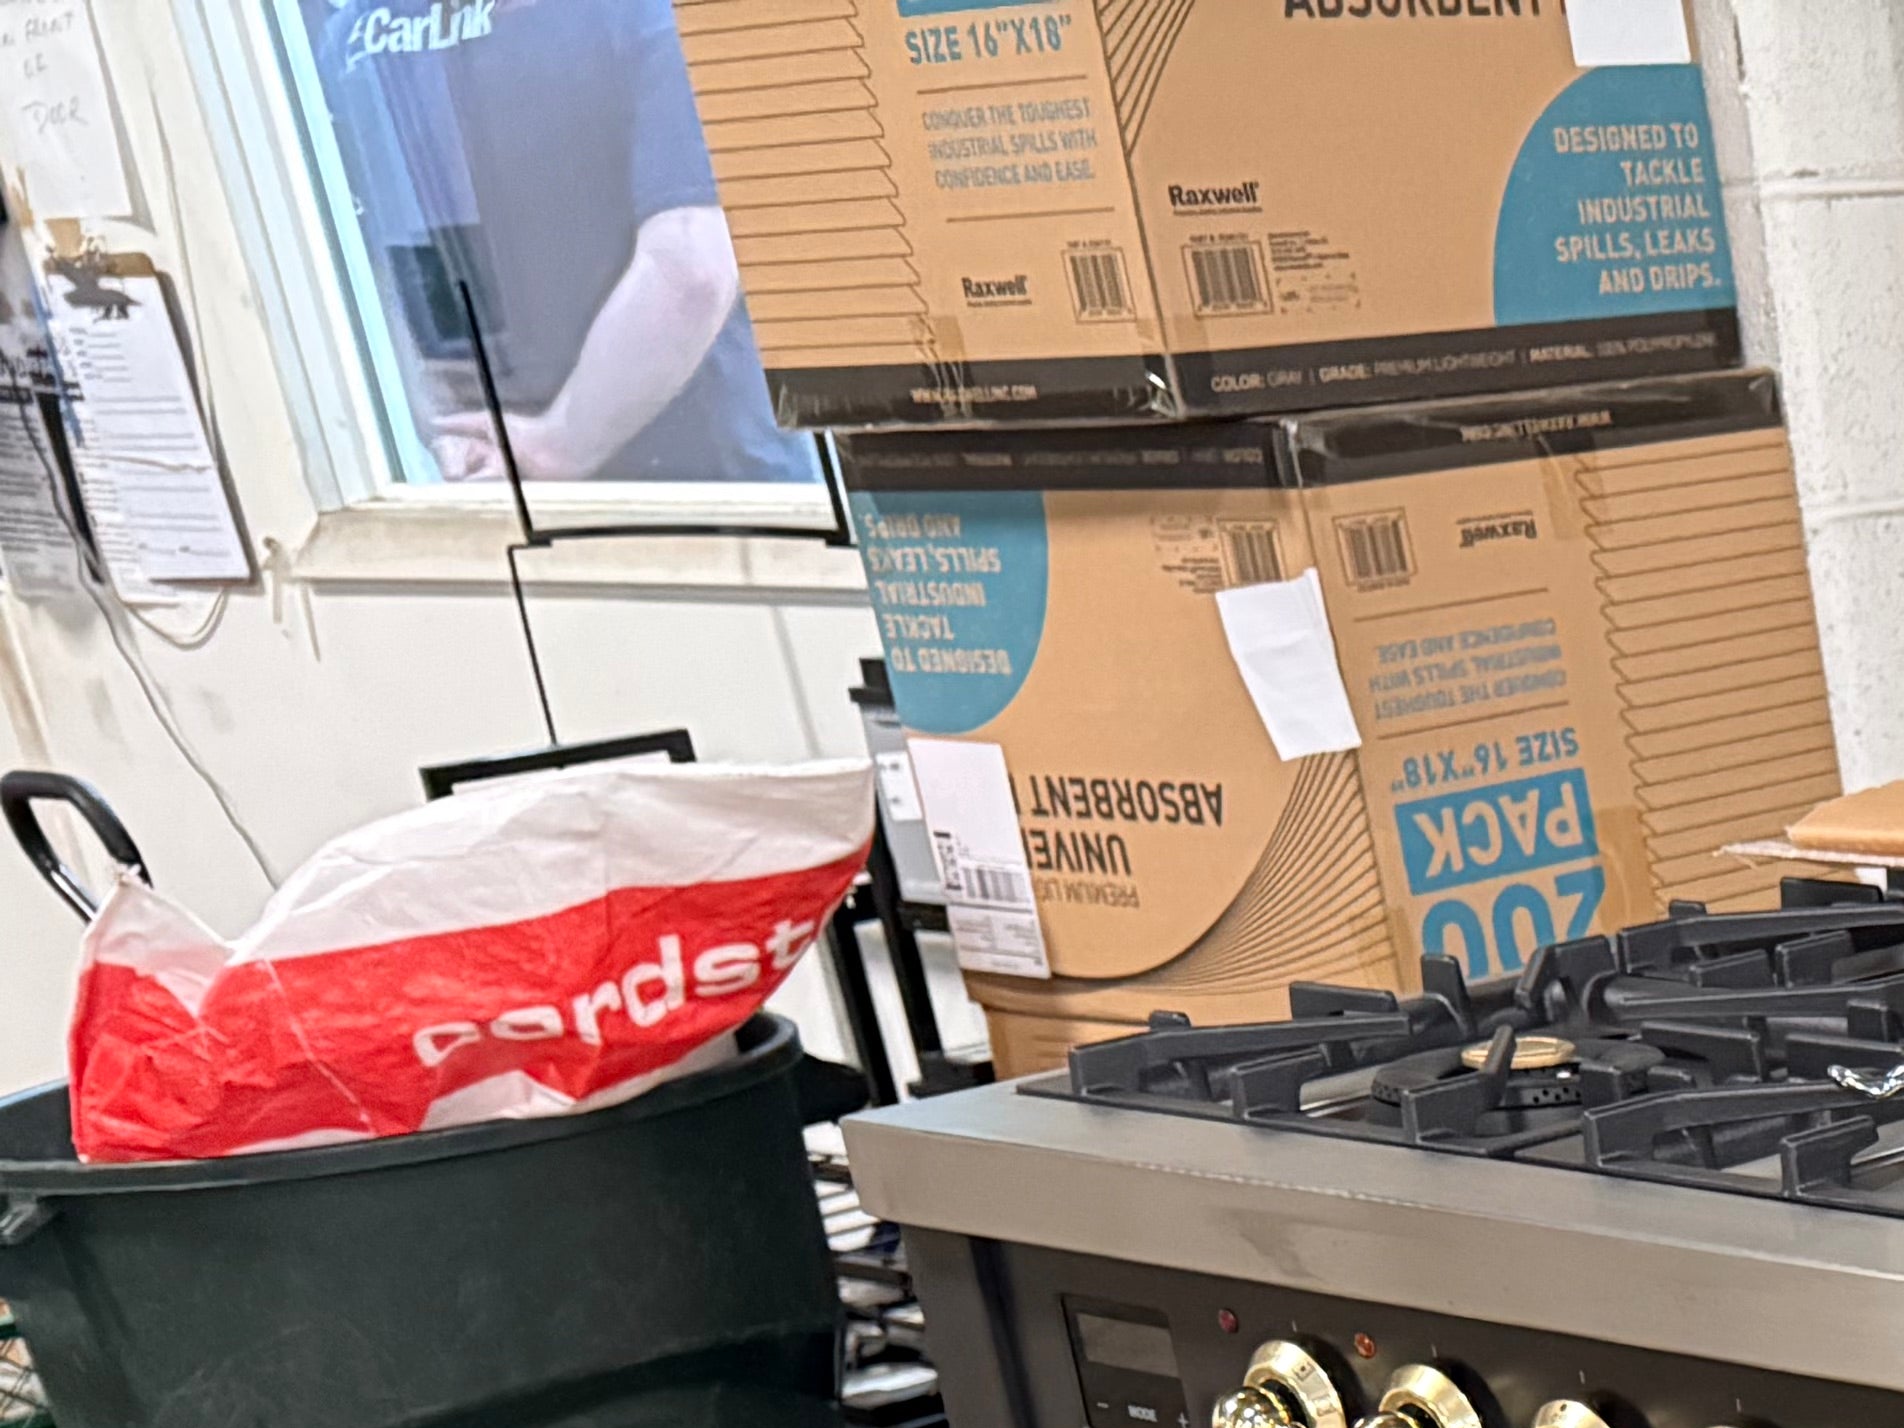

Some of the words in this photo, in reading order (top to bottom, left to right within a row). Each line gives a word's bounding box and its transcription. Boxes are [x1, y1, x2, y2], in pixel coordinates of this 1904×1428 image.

[905, 26, 962, 64] SIZE
[922, 107, 986, 131] CONQUER
[988, 104, 1016, 126] THE
[1018, 98, 1091, 122] TOUGHEST
[929, 135, 1009, 159] INDUSTRIAL
[1010, 130, 1059, 154] SPILLS
[1061, 128, 1098, 150] WITH
[1554, 125, 1668, 153] DESIGNED
[1671, 123, 1699, 149] TO
[935, 164, 1022, 190] CONFIDENCE
[1024, 162, 1054, 183] AND
[1620, 158, 1704, 187] TACKLE
[1168, 182, 1260, 206] Raxwell
[1578, 194, 1710, 224] INDUSTRIAL
[1555, 235, 1641, 263] SPILLS,
[1645, 229, 1716, 256] LEAKS
[961, 275, 1028, 298] Raxwell
[1599, 269, 1645, 295] AND
[1649, 262, 1721, 291] DRIPS.
[923, 514, 961, 539] AND
[875, 580, 987, 607] INDUSTRIAL
[884, 613, 955, 640] TACKLE
[1459, 618, 1557, 650] CONFIDENCE
[891, 647, 917, 672] TO
[1421, 635, 1454, 655] AND
[1471, 644, 1562, 673] INDUSTRIAL
[918, 648, 1013, 676] DESIGNED
[1412, 660, 1469, 685] SPILLS
[1369, 670, 1412, 693] WITH
[1459, 683, 1491, 705] THE
[1494, 669, 1567, 698] CONQUER
[1375, 690, 1456, 720] TOUGHEST
[1516, 728, 1580, 766] SIZE
[1030, 775, 1222, 827] ABSORBENT
[1413, 782, 1584, 879] PACK
[1064, 883, 1140, 909] PREMIUM
[1421, 865, 1606, 980] 200
